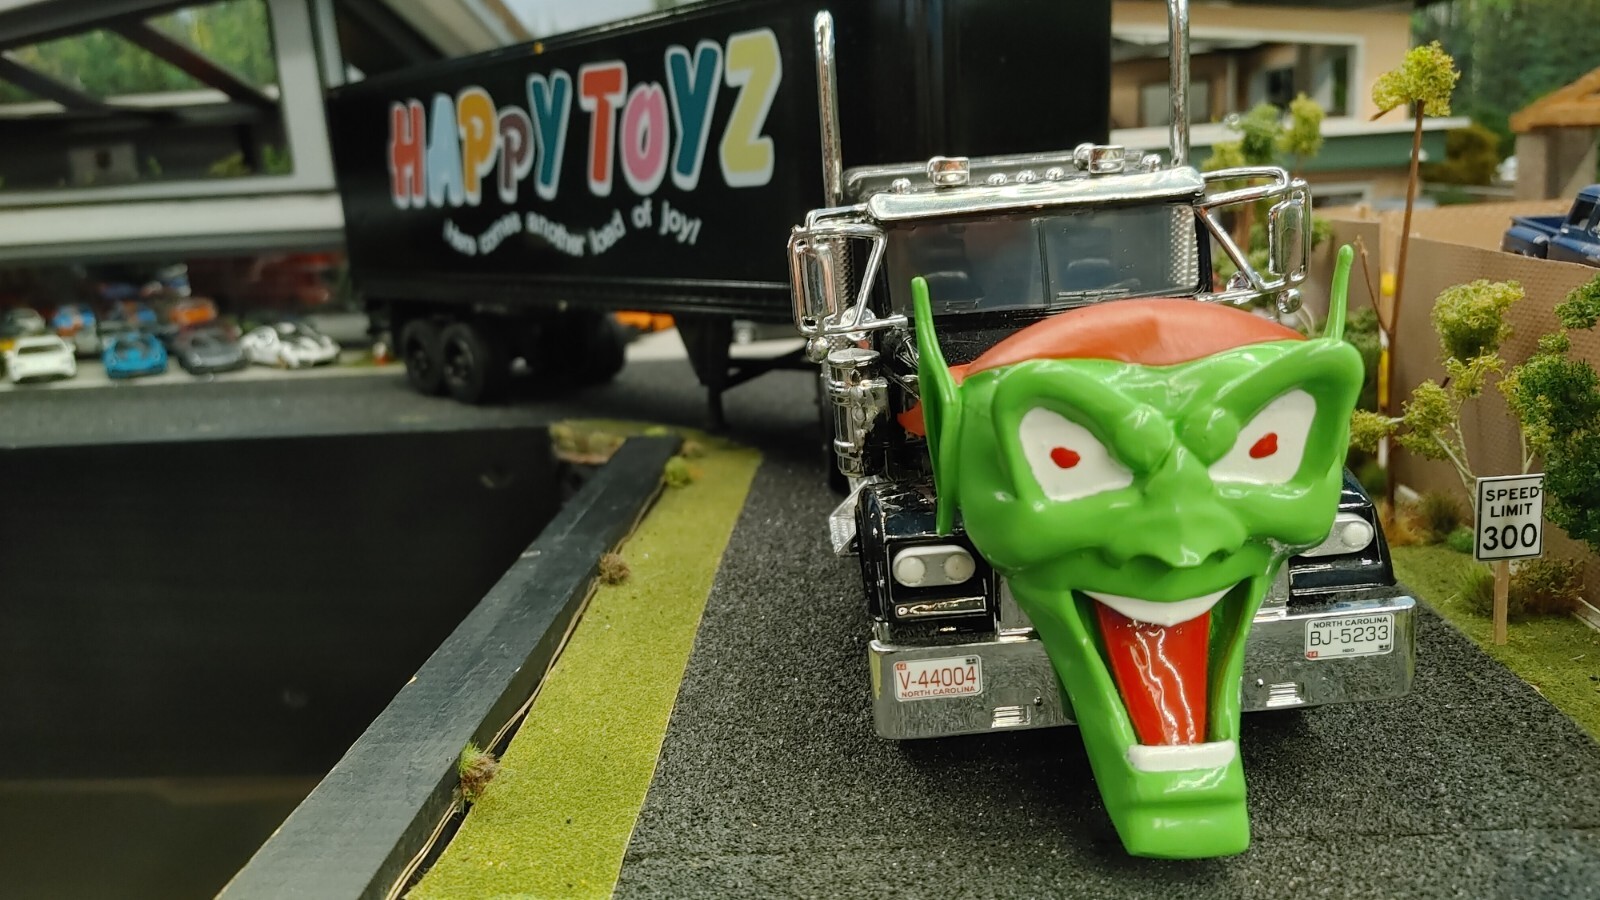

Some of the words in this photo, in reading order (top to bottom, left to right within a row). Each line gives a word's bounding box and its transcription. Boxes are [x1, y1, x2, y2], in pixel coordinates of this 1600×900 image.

[525, 211, 586, 256] another
[588, 209, 627, 255] load
[631, 198, 653, 229] of
[659, 200, 702, 245] joy!
[1485, 486, 1540, 502] SPEED
[1490, 503, 1533, 518] LIMIT
[1482, 523, 1538, 551] 300
[1313, 620, 1343, 629] NORTH
[1344, 616, 1389, 627] CAROLINA
[1310, 625, 1389, 646] BJ-5233
[899, 666, 977, 690] V-44004
[901, 689, 931, 698] NORTH
[932, 685, 976, 695] CAROLINA
